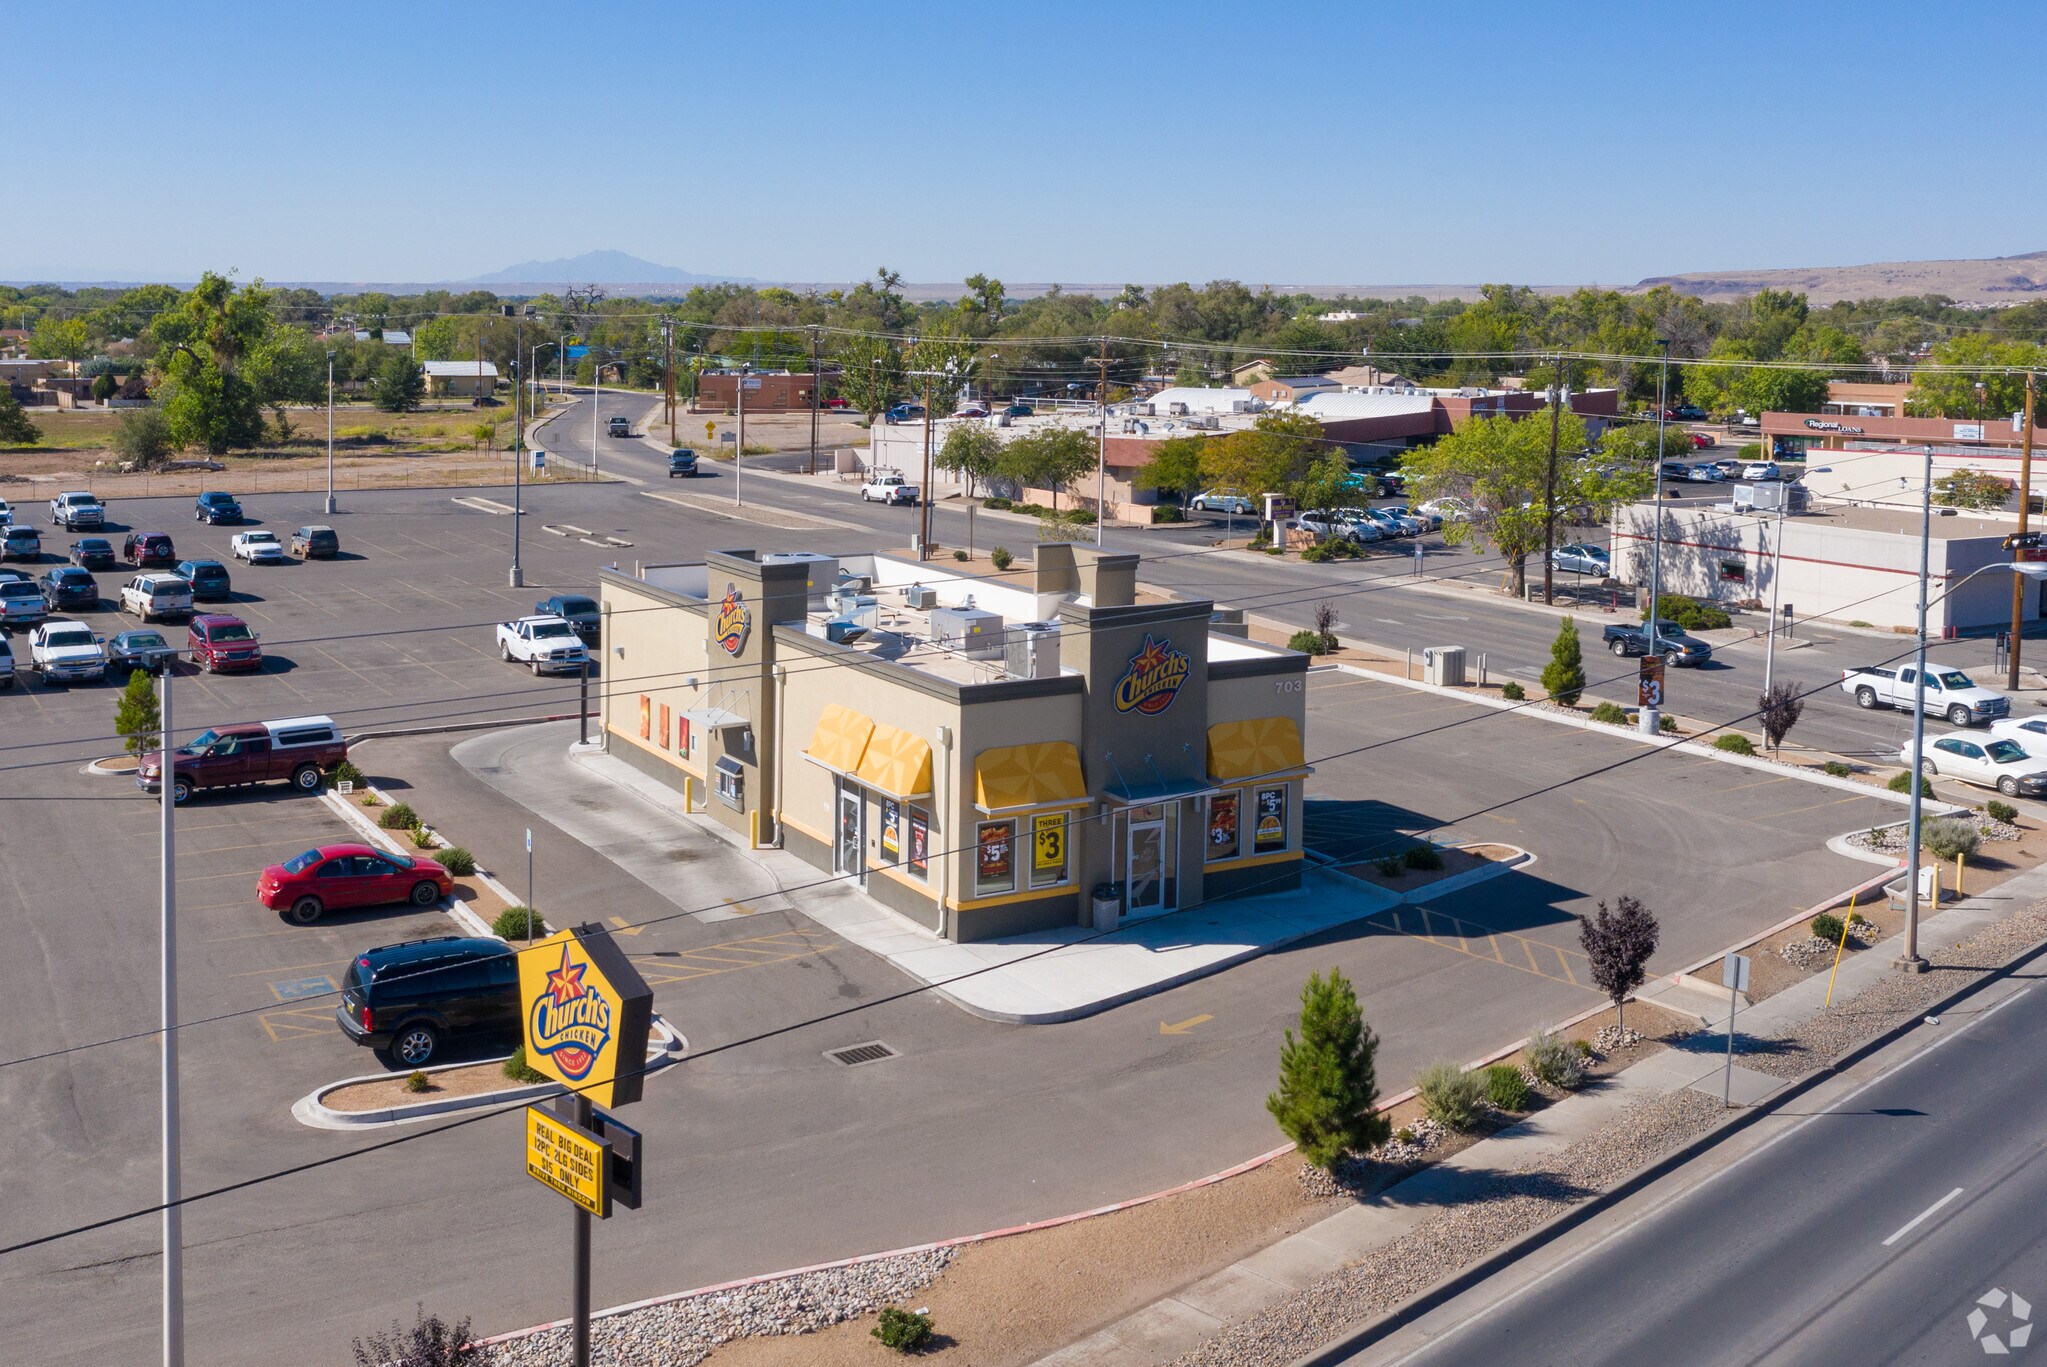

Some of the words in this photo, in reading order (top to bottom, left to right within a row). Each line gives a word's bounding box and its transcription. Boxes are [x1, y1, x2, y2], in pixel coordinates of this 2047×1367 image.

[1809, 420, 1838, 428] Regional
[1116, 652, 1188, 711] Church's
[1143, 677, 1178, 696] CHICKEN
[1275, 680, 1301, 694] 703
[1642, 679, 1660, 705] $3
[1038, 818, 1062, 828] THREE
[1039, 831, 1060, 859] $3
[530, 987, 609, 1052] Church's
[560, 1029, 597, 1047] CHICKEN
[559, 1050, 575, 1067] SINCE
[536, 1122, 555, 1144] REAL
[558, 1134, 572, 1154] BIG
[573, 1142, 594, 1166] DEAL
[534, 1136, 550, 1158] 12PC
[553, 1147, 568, 1168] 2LG
[569, 1157, 594, 1182] SIDES
[532, 1165, 549, 1181] DRIVE
[550, 1176, 566, 1191] THRU
[566, 1187, 591, 1206] WINDOW
[560, 1167, 579, 1190] ONLY
